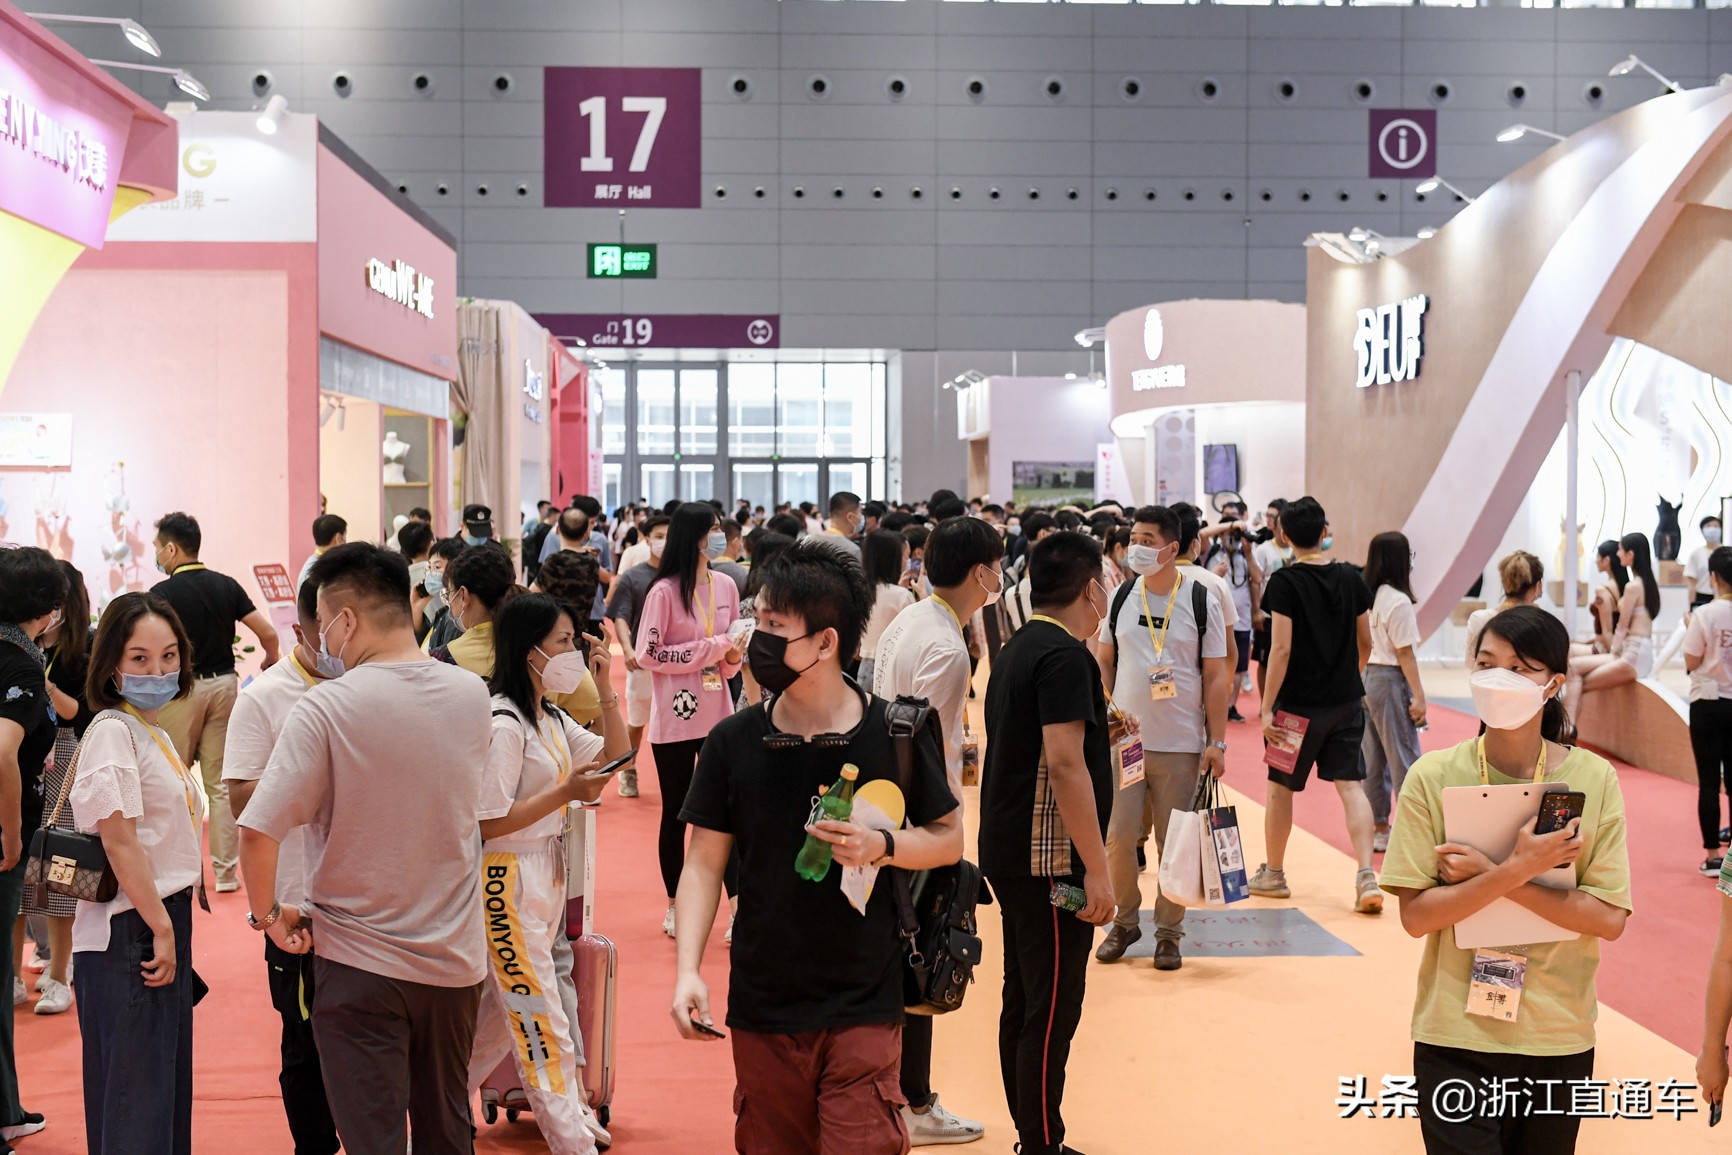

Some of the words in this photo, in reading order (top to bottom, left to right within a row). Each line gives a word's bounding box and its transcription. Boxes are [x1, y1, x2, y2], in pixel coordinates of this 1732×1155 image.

[579, 96, 667, 172] 17
[594, 184, 623, 199] 展厅
[628, 185, 651, 199] Hall
[592, 333, 618, 345] Gate
[622, 318, 653, 345] 19
[484, 865, 524, 976] BOOMYOU
